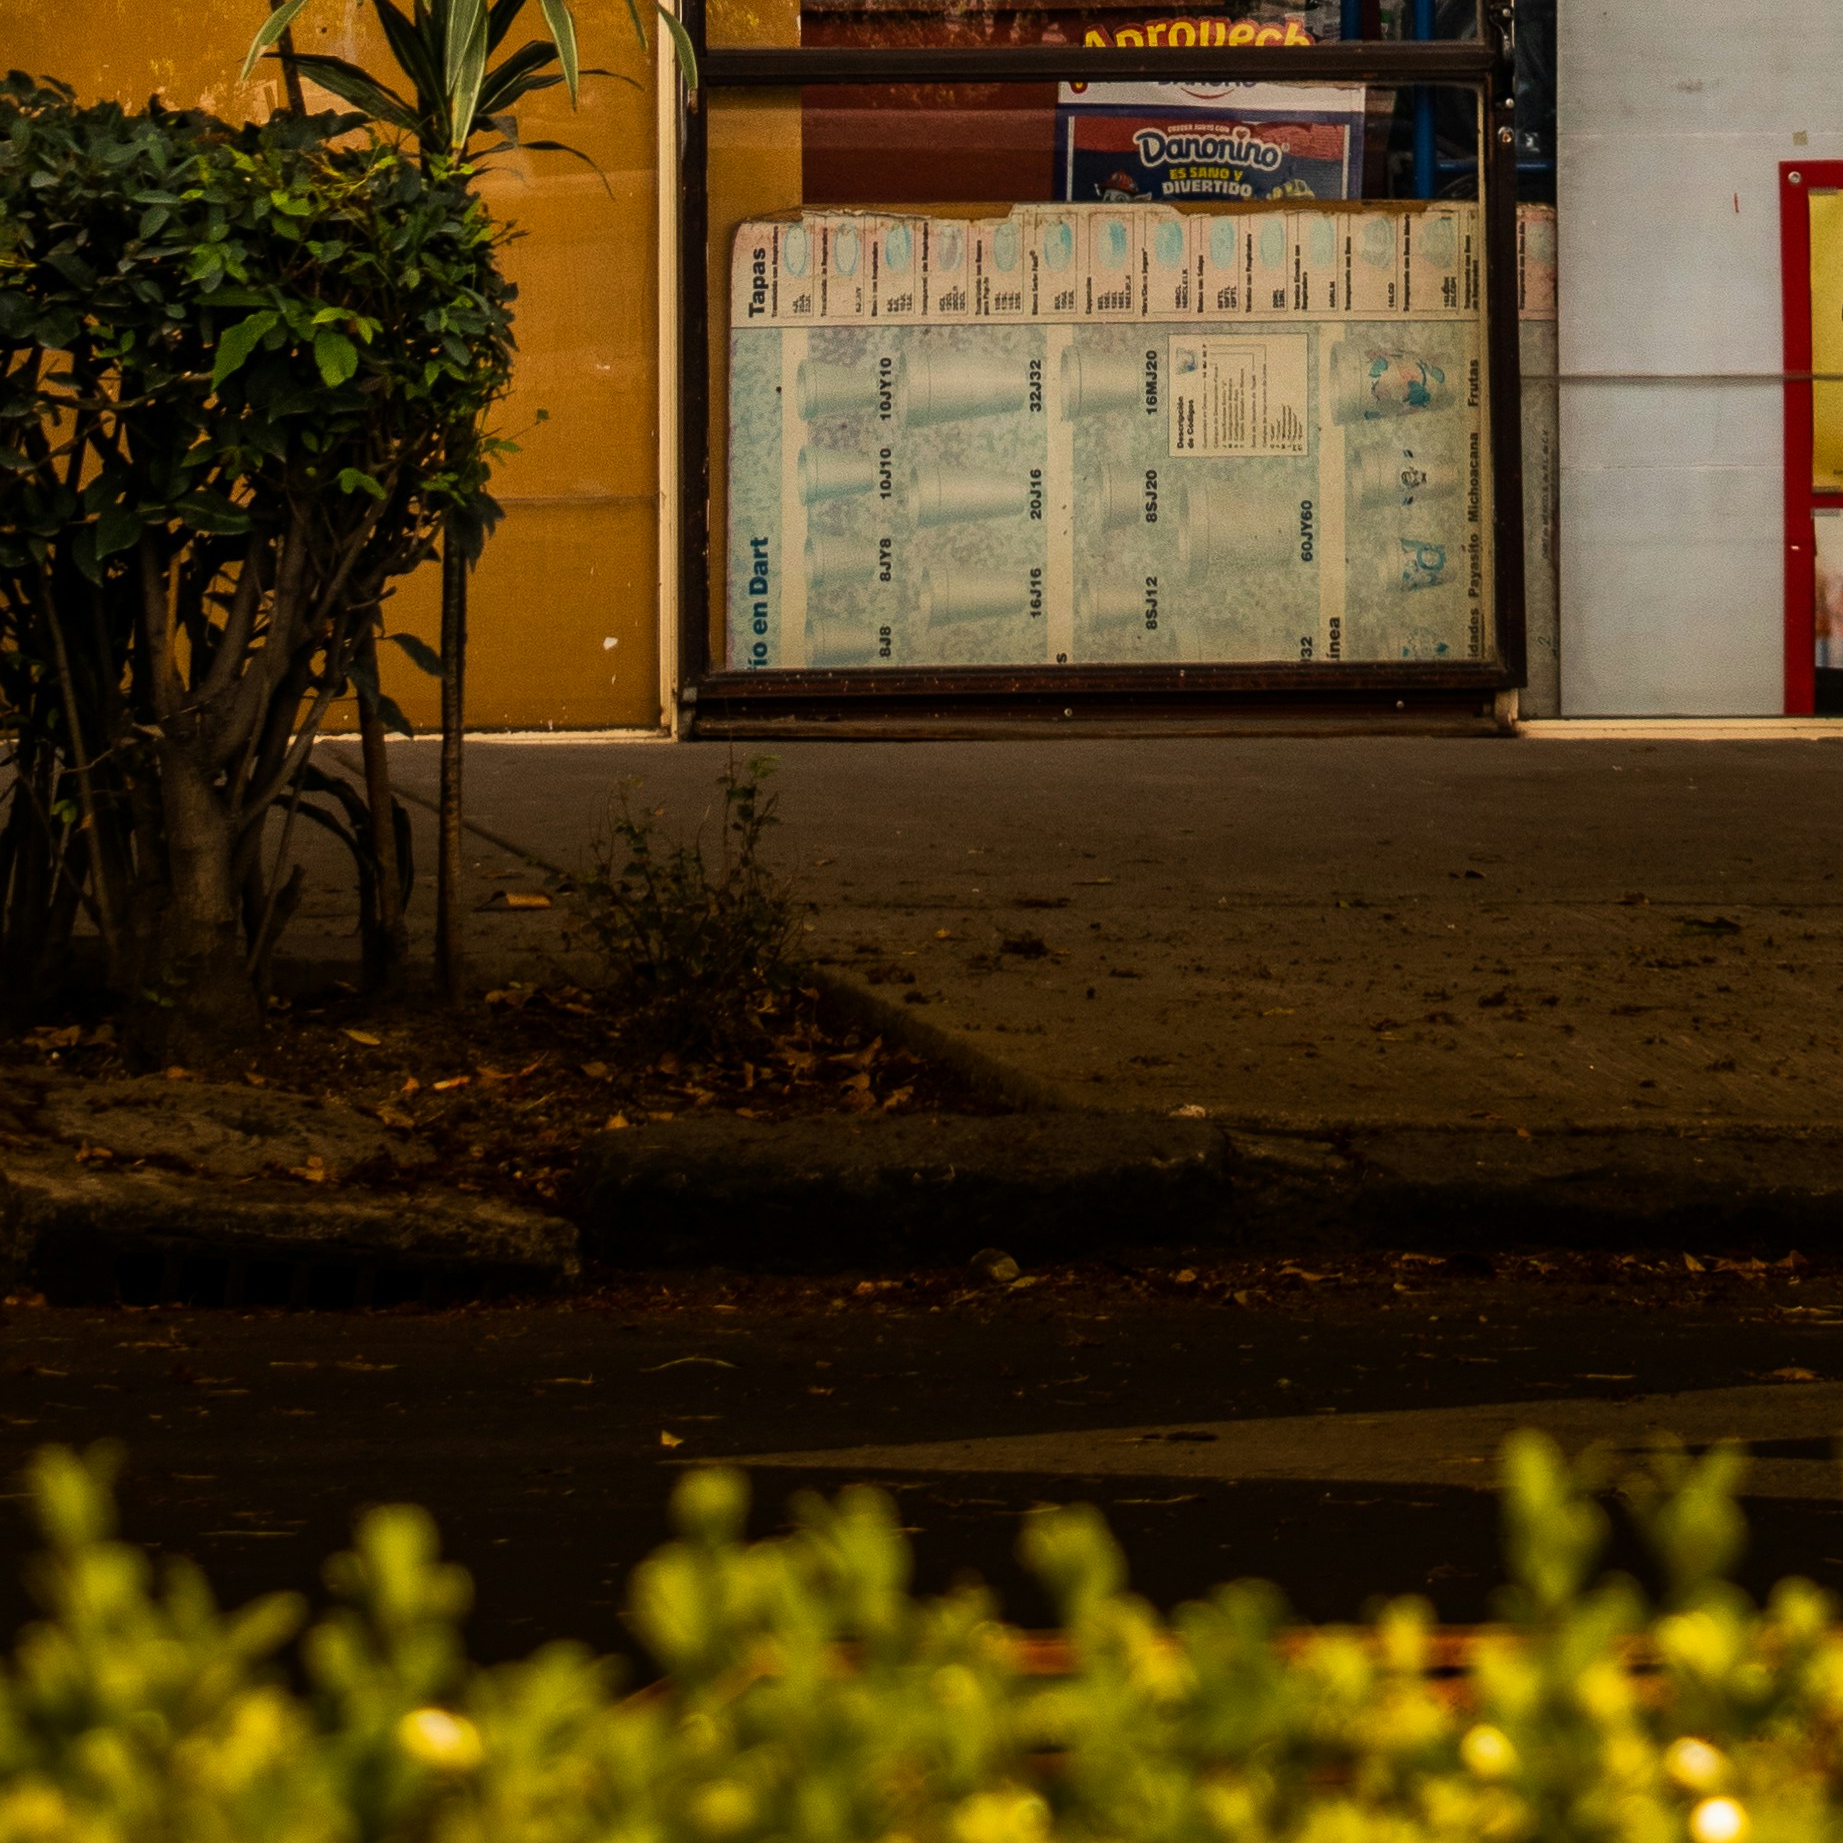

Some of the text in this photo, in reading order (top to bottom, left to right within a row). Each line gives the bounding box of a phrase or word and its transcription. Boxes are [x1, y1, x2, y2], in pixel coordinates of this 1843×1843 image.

[1135, 126, 1279, 168] Danonino
[1162, 180, 1253, 198] DIVERTIDO
[748, 247, 768, 318] Tapas
[879, 357, 893, 421] 10JY10
[1029, 359, 1043, 412] 32J32
[1145, 350, 1159, 415] 16MJ20
[1467, 359, 1480, 407] Frutas
[879, 448, 893, 500] 10J10
[1029, 468, 1043, 521] 20J16
[1145, 469, 1159, 523] 8SJ20
[1467, 432, 1480, 523] Michoacana
[1300, 499, 1314, 562] 60JY60
[749, 536, 770, 596] Dart
[879, 537, 893, 582] 8JY8
[752, 602, 769, 636] en
[1029, 567, 1043, 619] 16J16
[1145, 576, 1159, 631] 8SJ12
[879, 625, 893, 658] 8J8
